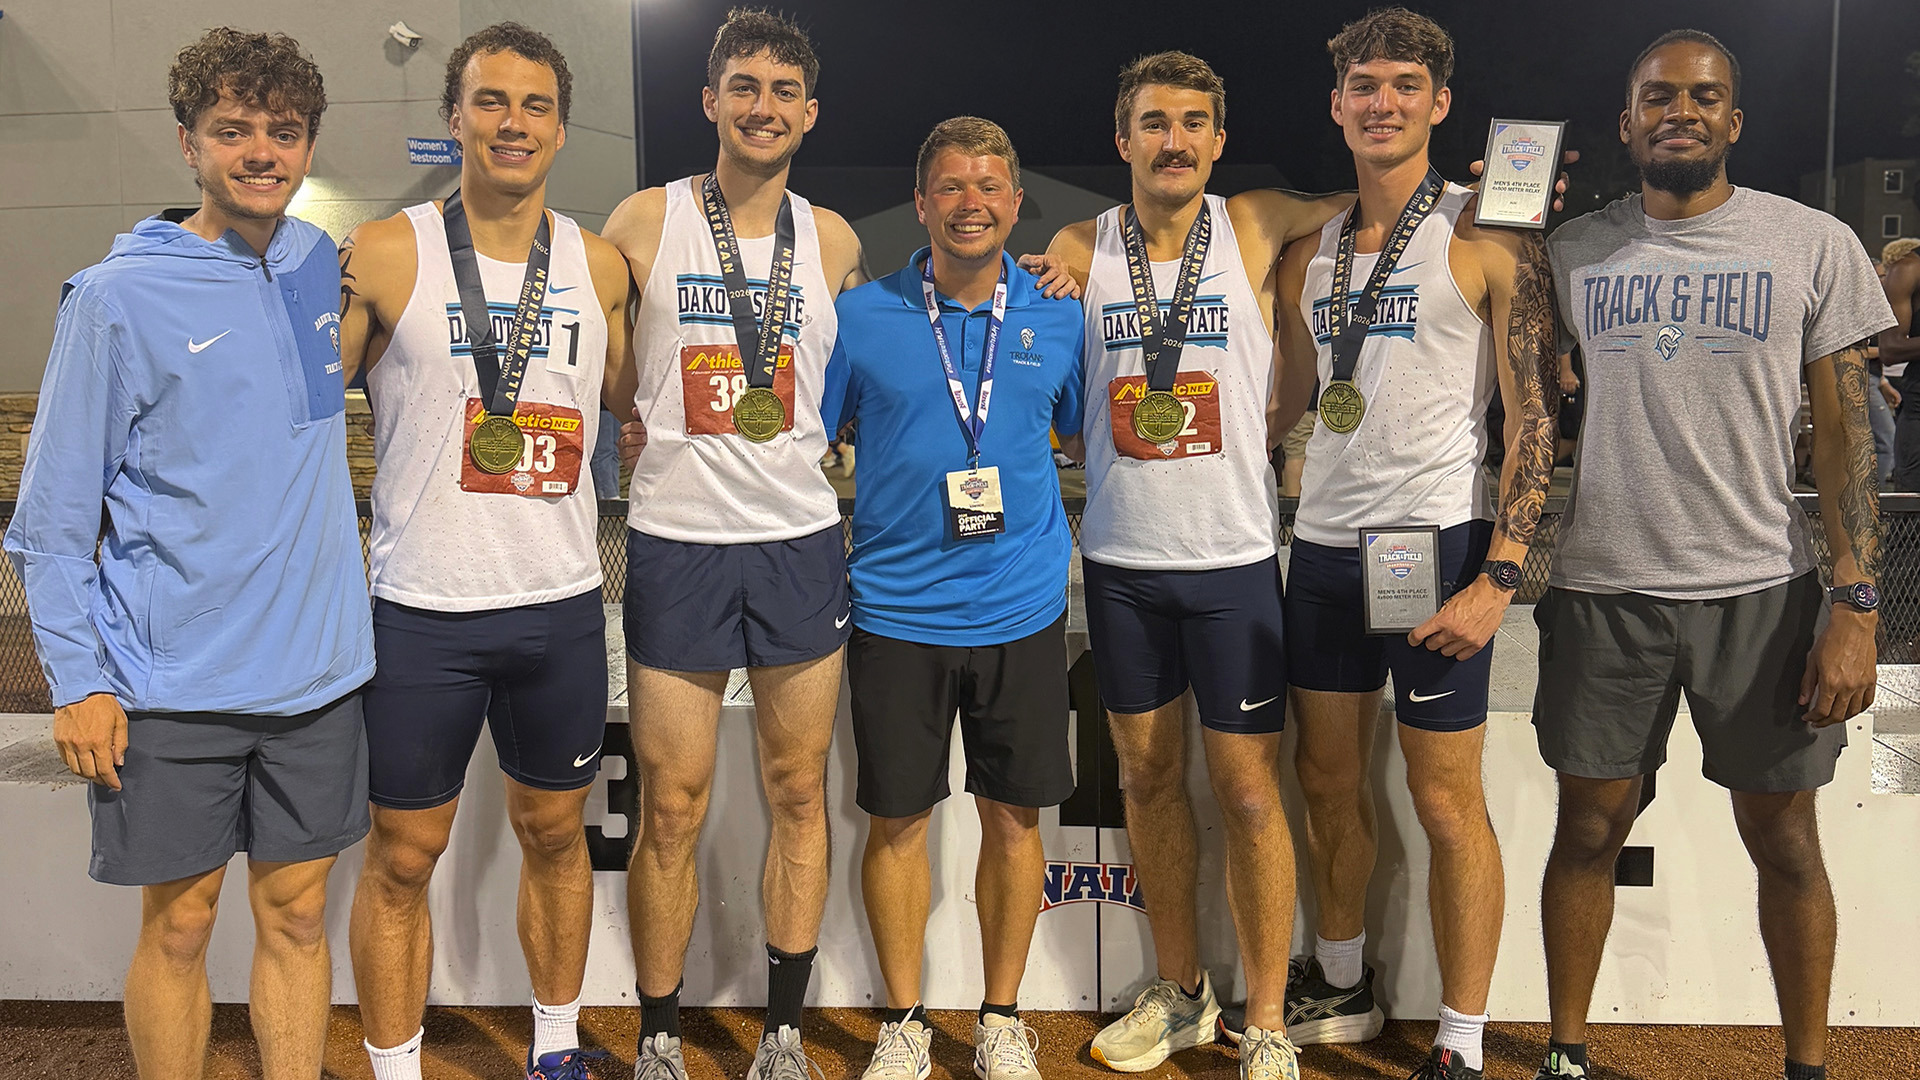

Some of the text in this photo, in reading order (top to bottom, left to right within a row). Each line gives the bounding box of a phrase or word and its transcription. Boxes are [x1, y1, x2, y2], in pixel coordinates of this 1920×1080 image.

[408, 140, 448, 151] Women's
[410, 152, 452, 163] Restroom
[1380, 233, 1398, 265] OUTDOOR
[1395, 213, 1409, 234] TRACK
[1408, 193, 1422, 210] FIELD
[533, 239, 549, 255] 2026
[772, 261, 780, 279] FIELD
[1178, 258, 1190, 289] OUTDOOR
[1186, 239, 1196, 258] TRACK
[522, 281, 532, 299] FIELD
[730, 289, 750, 299] 2026
[768, 285, 776, 304] TRACK
[677, 286, 805, 323] DAKO STE
[1584, 272, 1773, 343] TRACK & FIELD
[516, 304, 525, 325] TRACK
[762, 304, 773, 338] OUTDOOR
[1189, 307, 1229, 333] TATE
[1353, 314, 1370, 326] 2026
[506, 325, 520, 361] OUTDOOR
[562, 322, 580, 366] 1
[759, 339, 767, 355] NAIA
[1162, 338, 1183, 349] 2026
[686, 352, 743, 371] Athle
[1009, 351, 1044, 363] TROJANS
[1146, 352, 1160, 361] 20
[502, 362, 511, 379] NAIA
[709, 374, 748, 412] 38
[1189, 383, 1211, 392] NET
[554, 420, 576, 429] NET
[958, 513, 997, 525] OFFICIAL
[959, 522, 987, 532] PARTY
[1379, 554, 1400, 563] TRACK
[1403, 553, 1422, 562] FIELD
[1041, 863, 1147, 911] NAI
